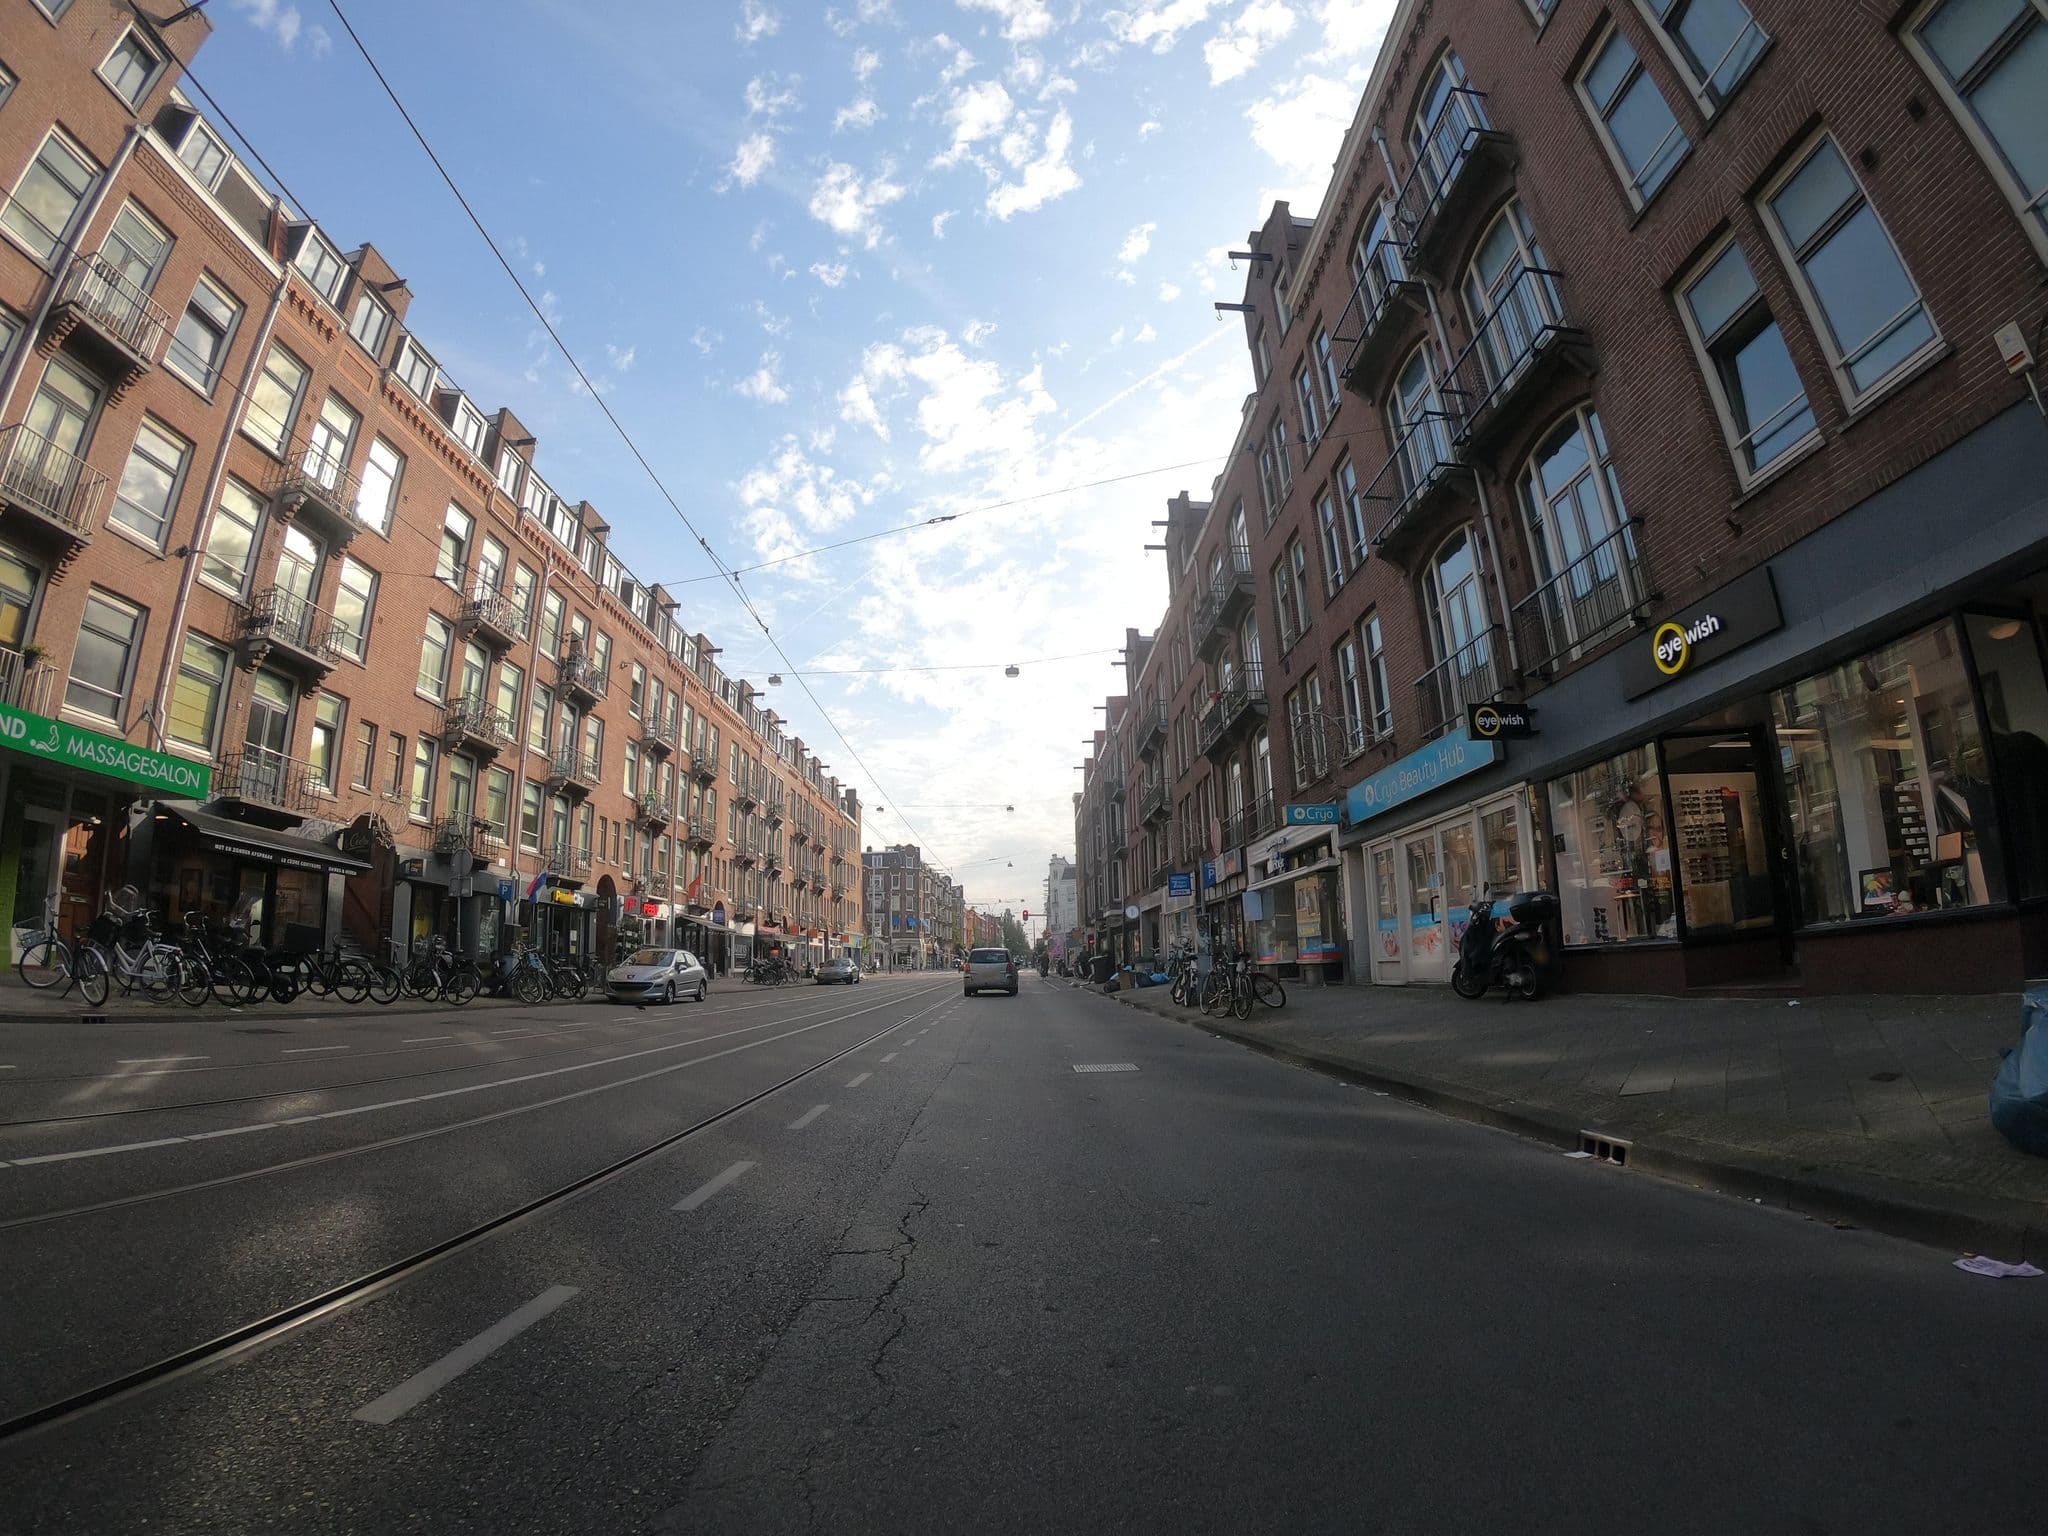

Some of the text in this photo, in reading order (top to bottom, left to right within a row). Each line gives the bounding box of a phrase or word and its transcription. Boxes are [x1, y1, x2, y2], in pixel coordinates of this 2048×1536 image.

[66, 735, 200, 789] MASSAGESALON
[1373, 743, 1465, 803] Cryo Beauty Hub
[1306, 807, 1334, 822] Cryo
[1208, 868, 1215, 880] P
[502, 886, 508, 895] P
